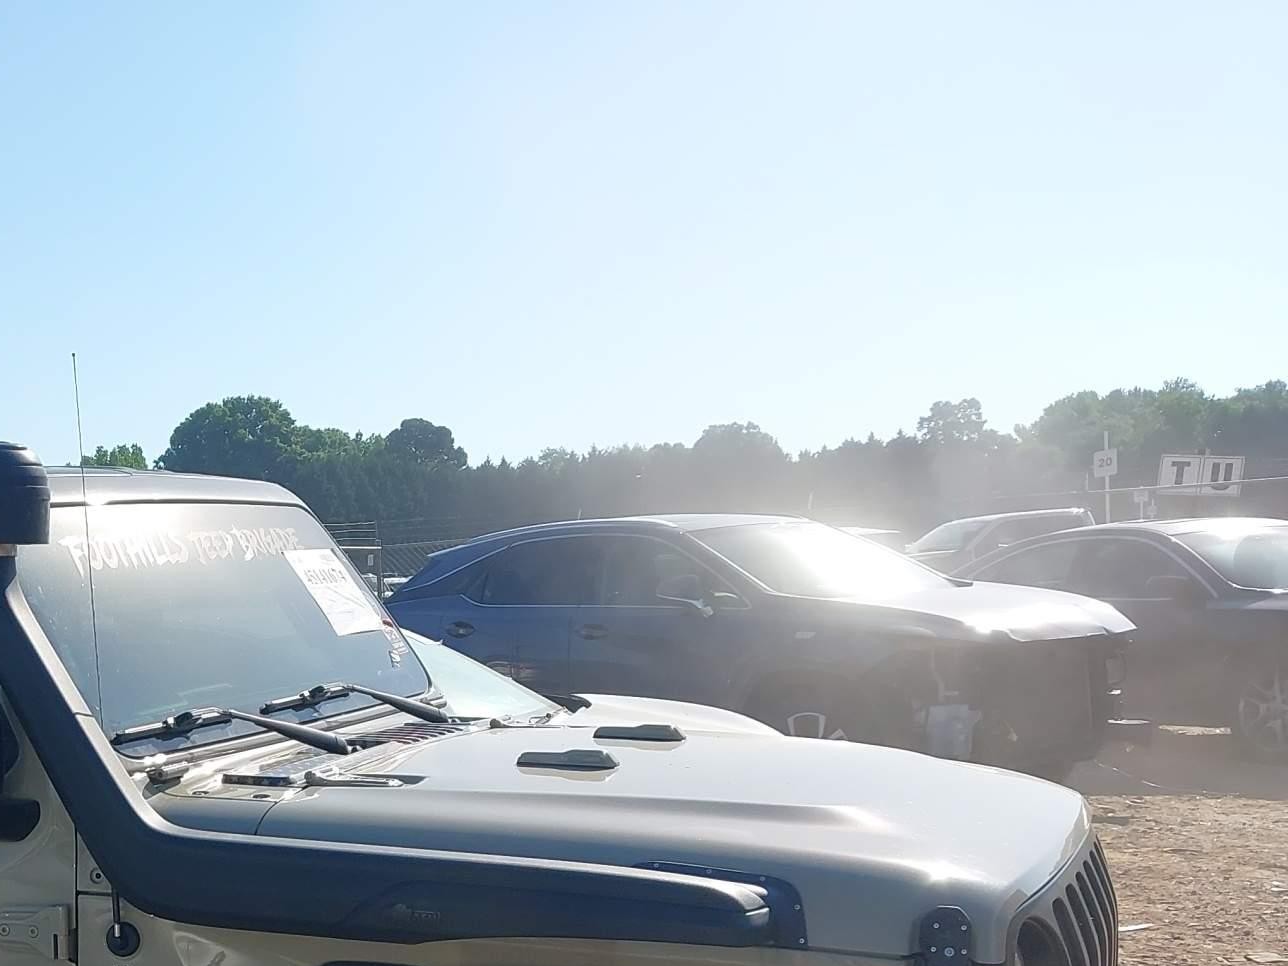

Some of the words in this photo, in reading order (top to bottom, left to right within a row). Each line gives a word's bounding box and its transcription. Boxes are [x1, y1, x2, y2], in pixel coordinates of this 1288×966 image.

[1098, 457, 1112, 468] 20
[1171, 461, 1191, 486] T
[1211, 462, 1235, 491] U
